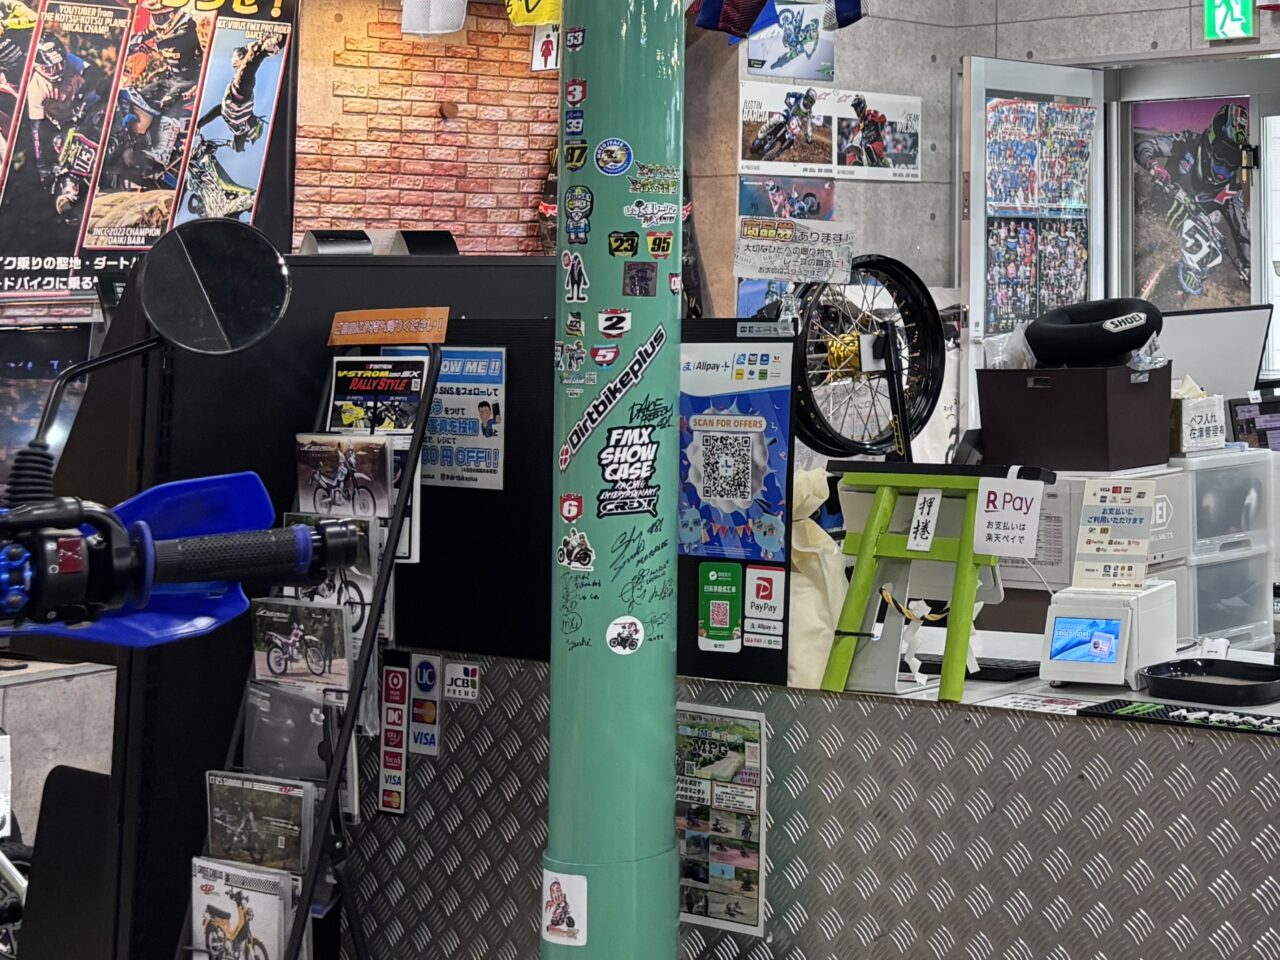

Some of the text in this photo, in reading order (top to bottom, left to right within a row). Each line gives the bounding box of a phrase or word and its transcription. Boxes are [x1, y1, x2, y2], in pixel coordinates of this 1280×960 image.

[59, 5, 97, 17] YOUTUBER
[41, 12, 54, 21] THE
[105, 17, 131, 28] PLANET
[566, 32, 582, 44] 53
[568, 85, 583, 100] 3
[566, 120, 583, 132] 39
[126, 228, 160, 236] CHAMPION
[127, 237, 145, 245] BABA
[613, 238, 635, 252] 23
[651, 237, 671, 252] 95
[0, 256, 138, 270] ク乗りの聖地・ダート
[0, 275, 98, 290] ドバイクに乗る
[603, 316, 626, 330] 2
[1111, 314, 1144, 329] SHOEI
[595, 349, 616, 361] 5
[464, 360, 488, 373] ME
[696, 361, 720, 372] Alipay
[349, 378, 409, 390] RALLY STYLE
[569, 326, 665, 450] Dirtbikeplus
[693, 419, 763, 429] SCAN FOR OFFERS
[610, 427, 653, 445] FMX
[600, 444, 658, 464] SHOW
[604, 460, 654, 480] CASE
[563, 500, 578, 517] 6
[984, 490, 1034, 515] R Pay
[986, 521, 1026, 531] お支払いは
[1087, 517, 1144, 525] ご利用いただけます
[985, 533, 1025, 544] 楽天ペイで
[751, 601, 777, 614] PayPay
[417, 667, 434, 684] UC
[447, 677, 469, 688] JCB
[447, 689, 476, 698] PREMO
[387, 710, 402, 723] DC
[413, 732, 436, 746] VISA
[692, 739, 729, 757] MPG
[384, 774, 402, 785] VISA
